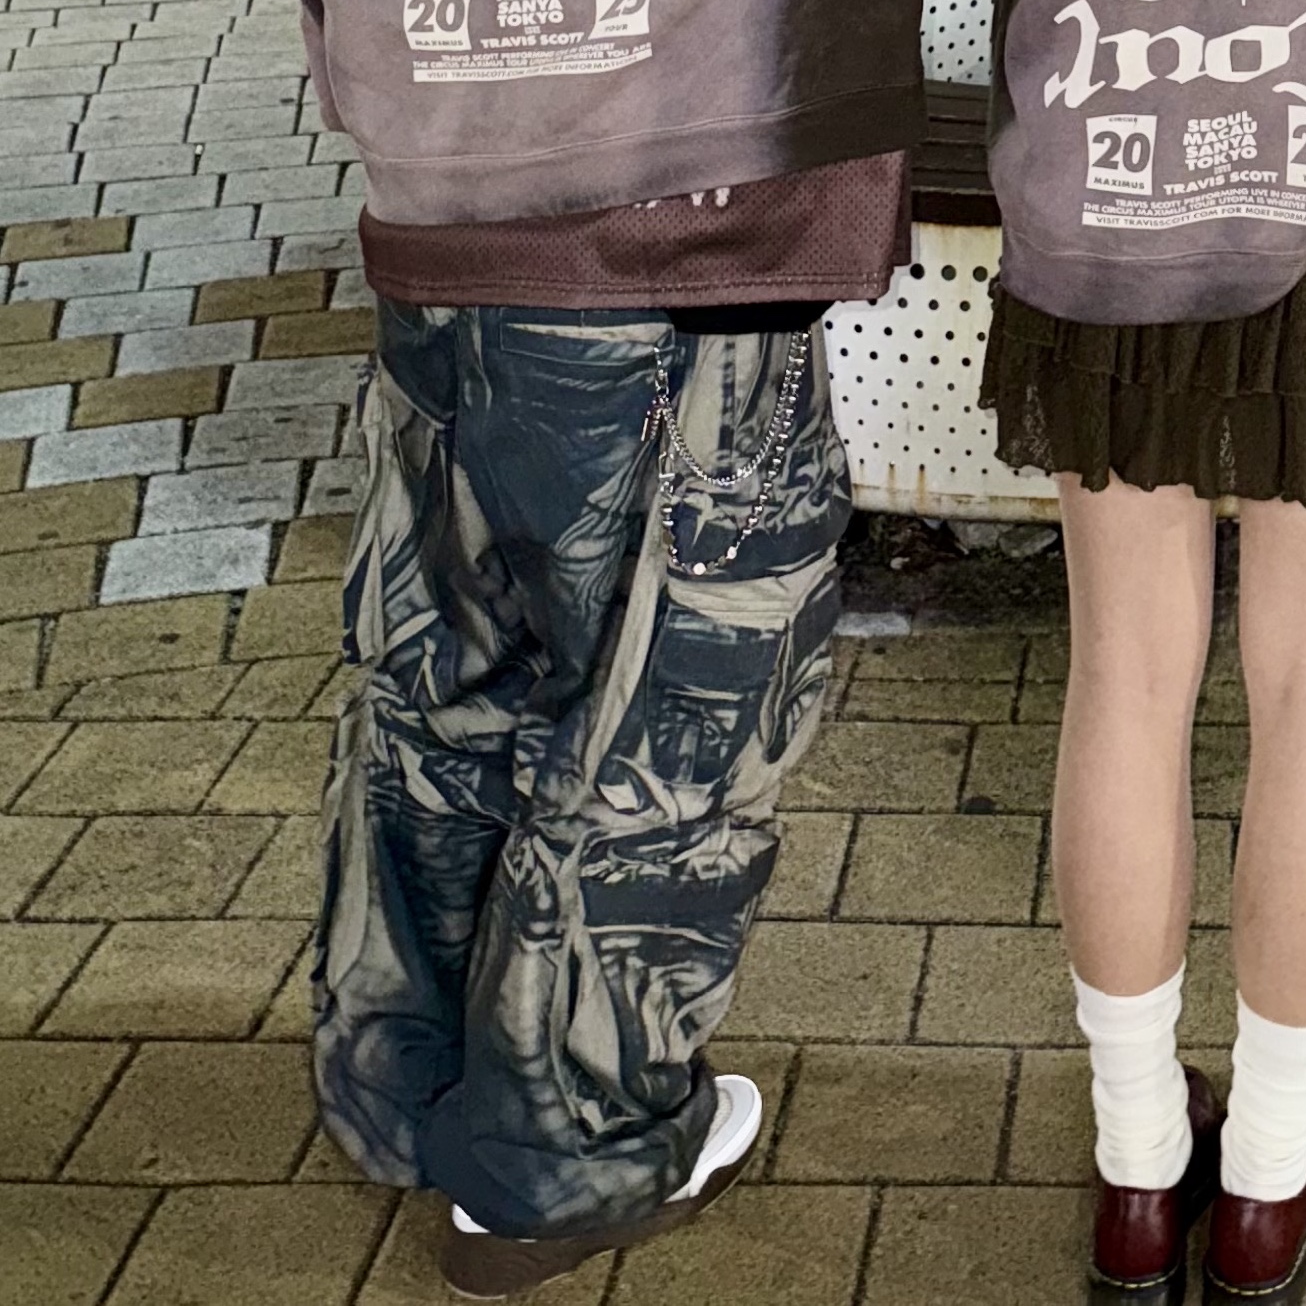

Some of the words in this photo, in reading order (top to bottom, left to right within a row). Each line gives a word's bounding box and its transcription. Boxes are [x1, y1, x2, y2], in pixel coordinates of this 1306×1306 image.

[496, 10, 564, 28] TOKYO
[480, 35, 537, 49] TRAVIS
[540, 31, 585, 46] SCOTT
[413, 60, 428, 69] THE
[606, 49, 630, 59] YOU
[472, 52, 499, 62] SCOTT
[1187, 110, 1253, 133] SEOUL
[1183, 121, 1258, 146] MACAU
[1092, 130, 1151, 173] 20
[1185, 134, 1257, 159] SANYA
[1184, 146, 1258, 172] TOKYO
[1093, 177, 1145, 190] MAXIMUS
[1163, 174, 1226, 196] TRAVIS
[1229, 170, 1279, 184] SCOTT
[1083, 202, 1100, 212] THE
[1101, 204, 1135, 215] CIRCUS
[1137, 206, 1187, 217] MAXIMUS
[1189, 197, 1216, 211] TOUR
[1218, 195, 1255, 205] UTOPIA
[1256, 196, 1266, 204] IS
[1266, 197, 1306, 210] WHEREVER
[1115, 198, 1149, 210] TRAVIS
[1151, 199, 1182, 210] SCOTT
[1183, 187, 1249, 205] PERFORMING
[1250, 188, 1268, 197] LIVE
[1270, 189, 1280, 198] IN
[1096, 215, 1120, 224] VISIT
[1222, 207, 1242, 215] FOR
[1245, 207, 1271, 217] MORE
